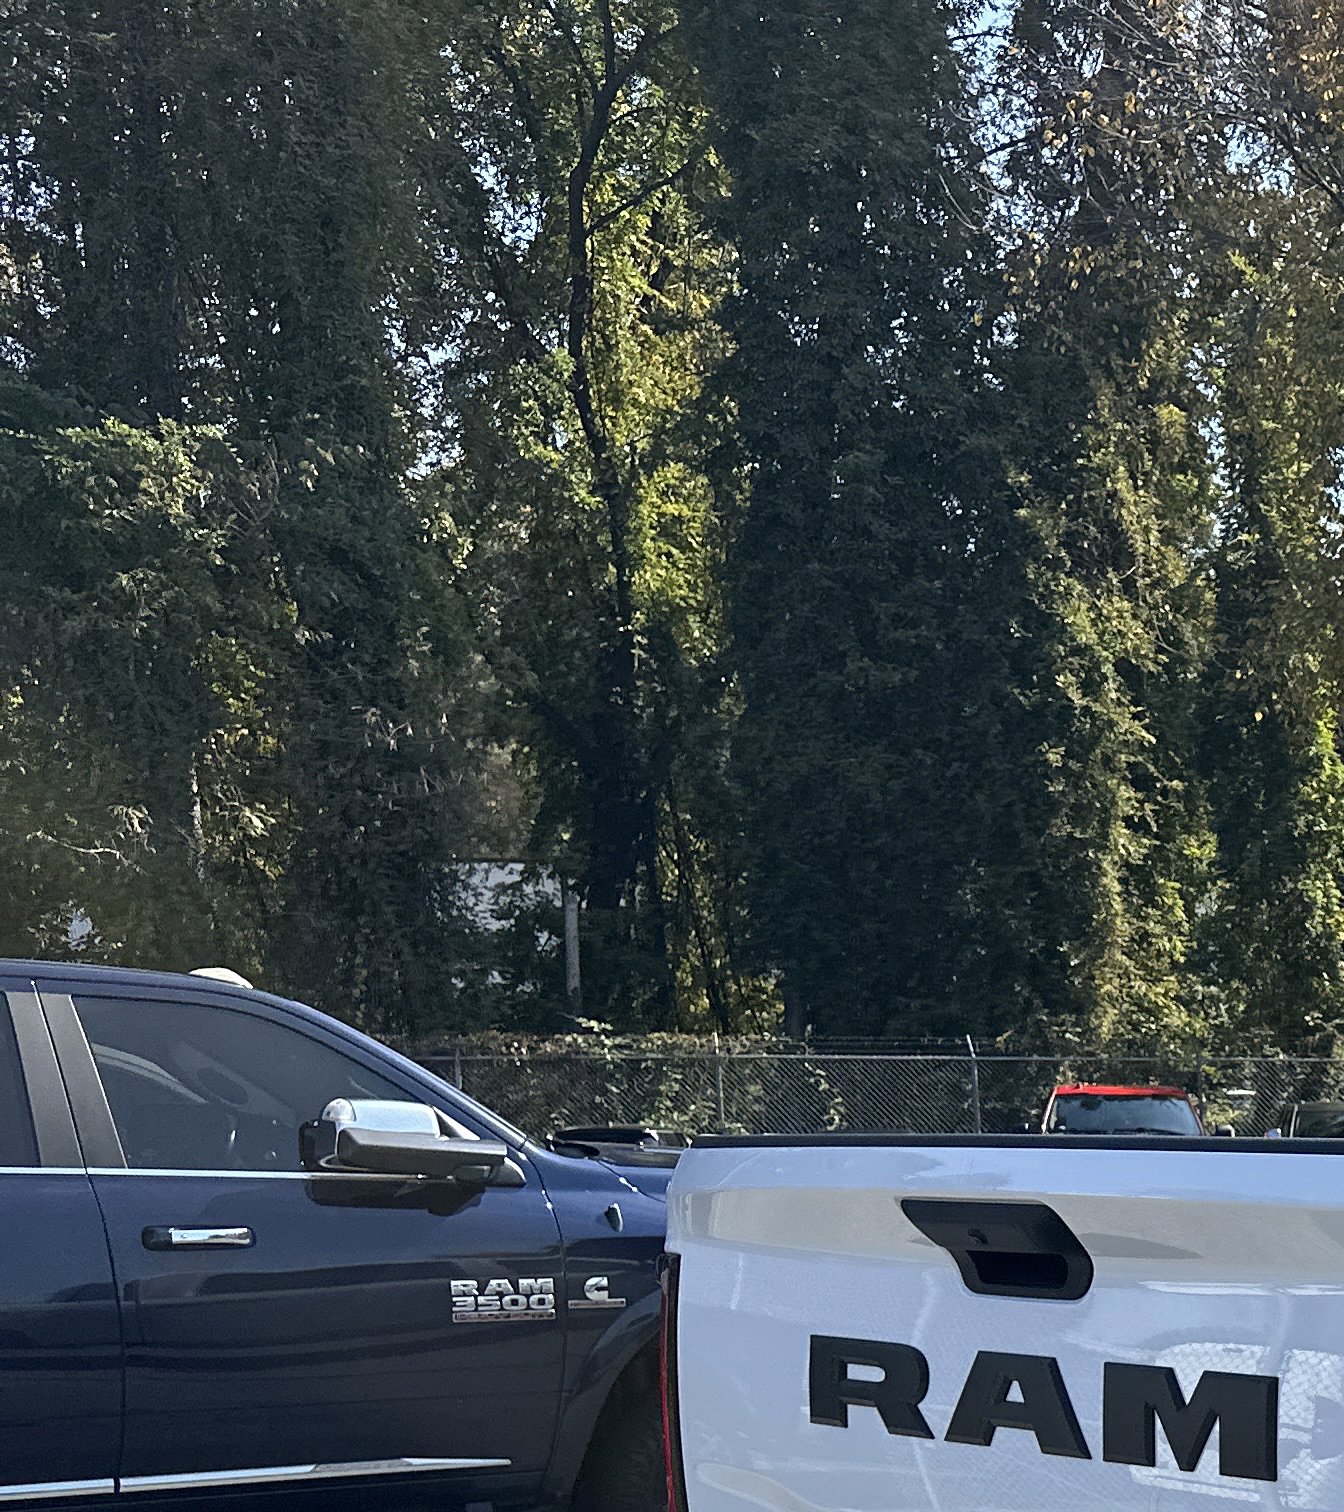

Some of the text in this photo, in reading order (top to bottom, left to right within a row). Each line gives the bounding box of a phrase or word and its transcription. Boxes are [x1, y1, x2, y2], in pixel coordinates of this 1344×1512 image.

[450, 1277, 555, 1295] RAM
[451, 1293, 556, 1312] 3500
[809, 1334, 1279, 1482] RAM
